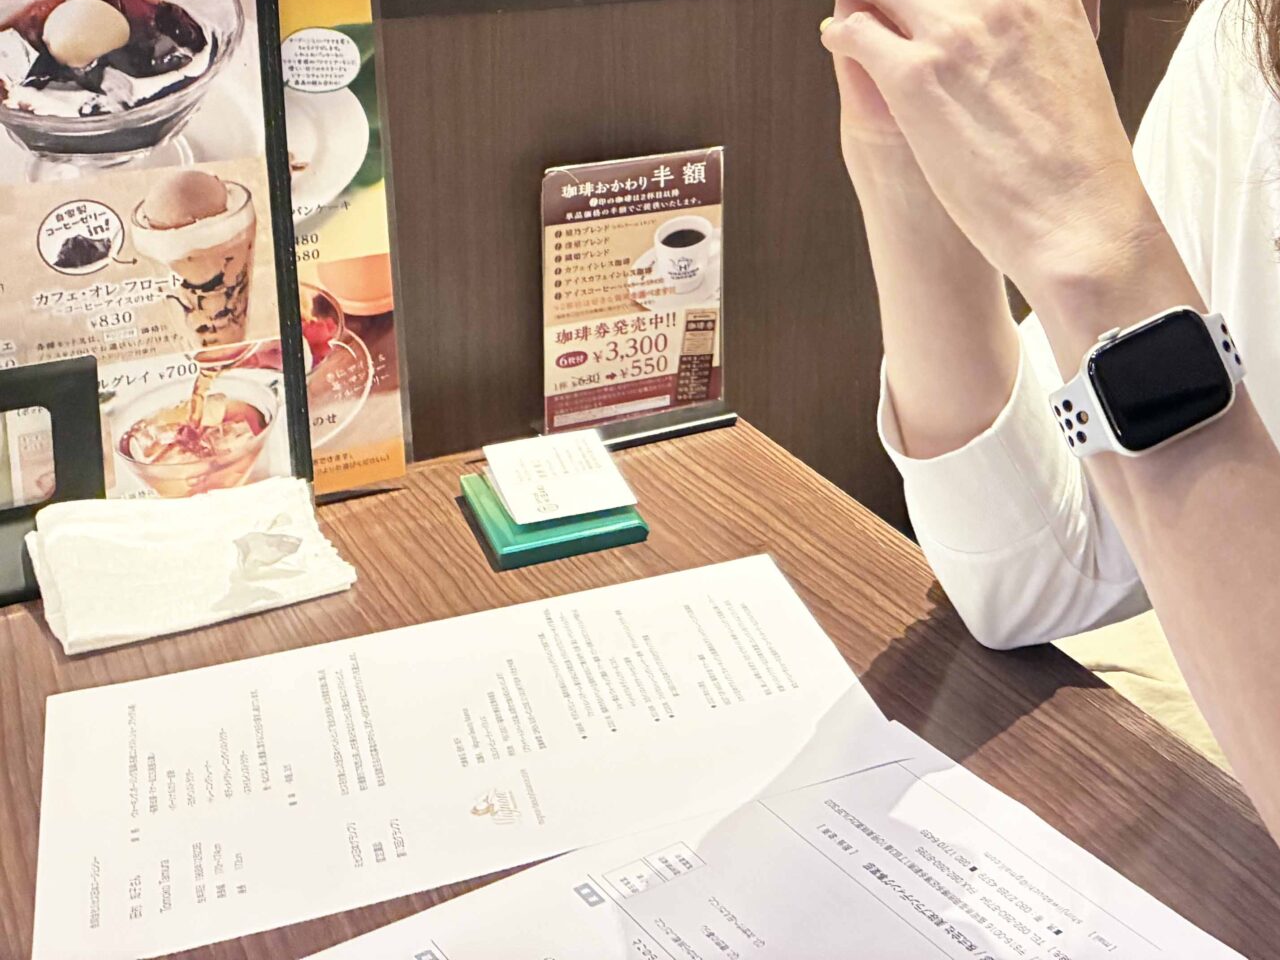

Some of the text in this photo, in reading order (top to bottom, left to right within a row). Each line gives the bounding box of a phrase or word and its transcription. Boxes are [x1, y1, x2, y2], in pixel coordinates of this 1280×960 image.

[561, 161, 707, 199] 珈琲おかわり 半額
[45, 211, 107, 237] コーヒーゼリー
[55, 205, 88, 223] 自家製
[87, 219, 111, 237] in!
[125, 274, 182, 293] フロート
[91, 311, 132, 329] ¥830
[555, 312, 677, 344] 珈琲券発売中!!
[593, 332, 669, 363] ¥3,300
[159, 362, 198, 381] ¥700
[619, 354, 669, 381] ¥550
[942, 922, 979, 955] 株式会社
